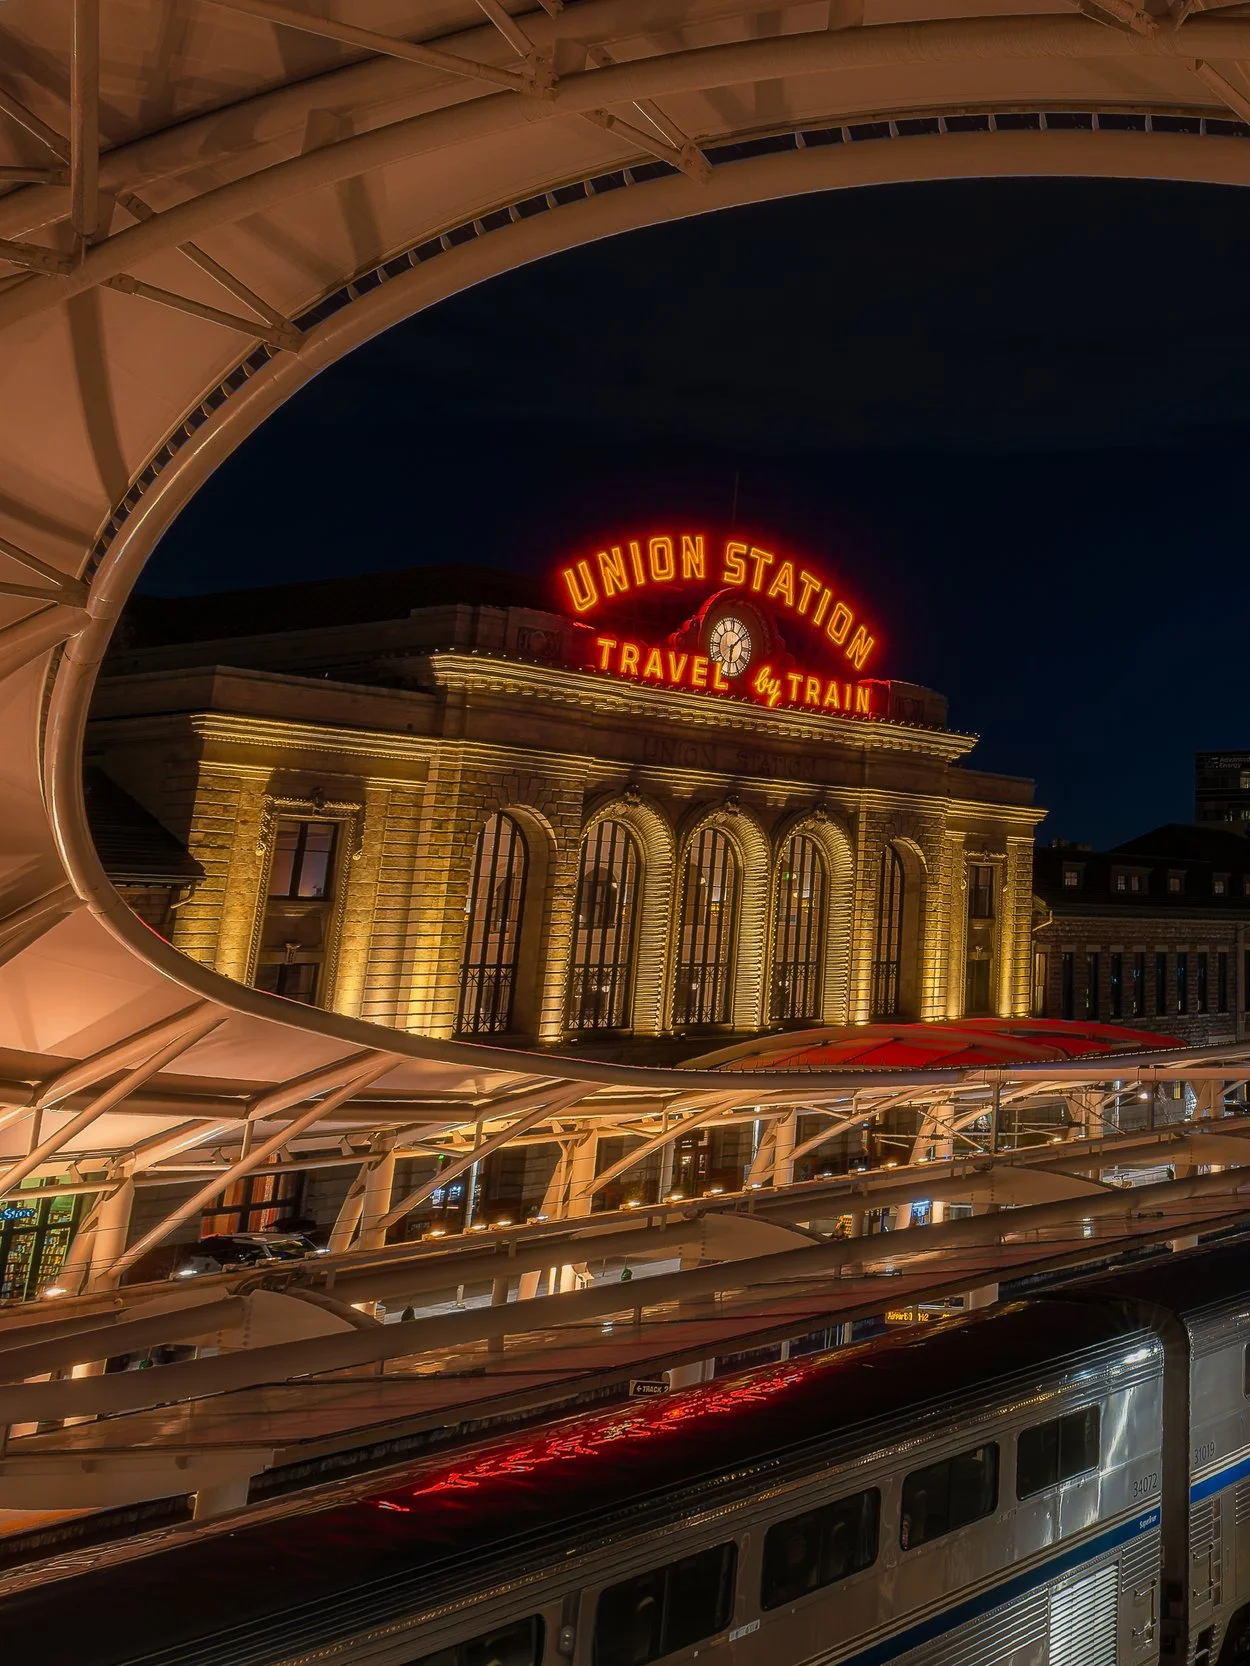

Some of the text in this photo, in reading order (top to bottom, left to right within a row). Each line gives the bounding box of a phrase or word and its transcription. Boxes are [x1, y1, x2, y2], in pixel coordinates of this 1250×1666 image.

[563, 535, 876, 671] UNION STATION
[596, 636, 872, 714] TRAVEL by TRAIN
[642, 1385, 663, 1393] TRACK
[1194, 1441, 1215, 1465] 31019
[1133, 1472, 1158, 1498] 34072
